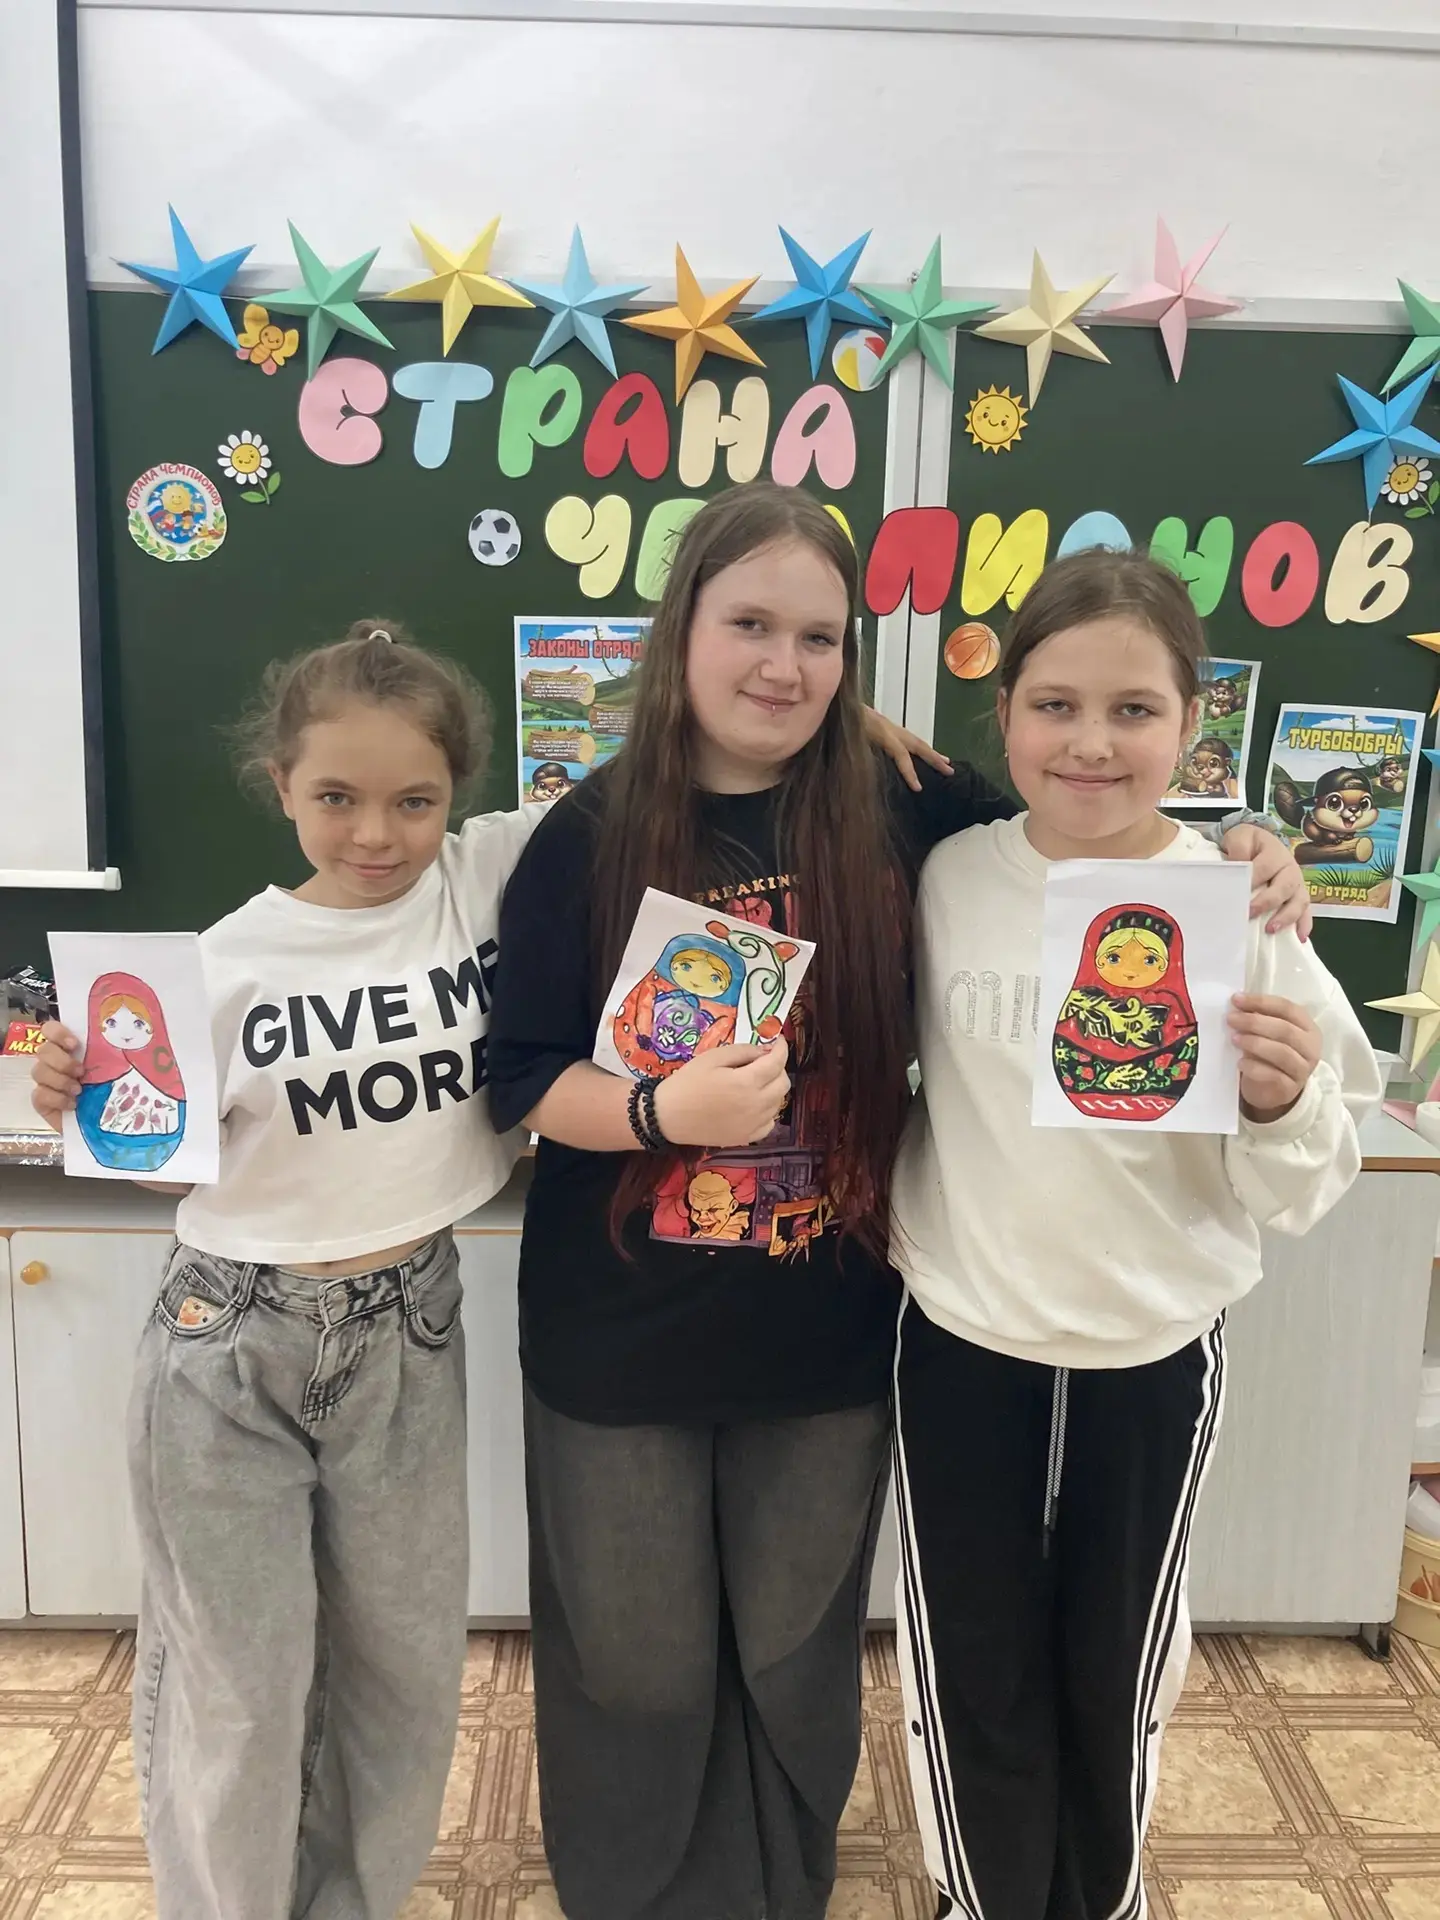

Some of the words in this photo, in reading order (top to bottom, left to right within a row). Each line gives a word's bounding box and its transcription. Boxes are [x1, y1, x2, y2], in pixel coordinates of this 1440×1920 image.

[299, 357, 857, 490] СТРАНА
[127, 470, 159, 509] СТРАНА
[160, 464, 222, 506] ЧЕМПИОНОВ
[528, 638, 590, 658] ЗАКОНЫ
[1288, 727, 1404, 756] ТУРБОБОБРЫ
[1326, 885, 1368, 902] отряд
[242, 983, 418, 1069] GIVE
